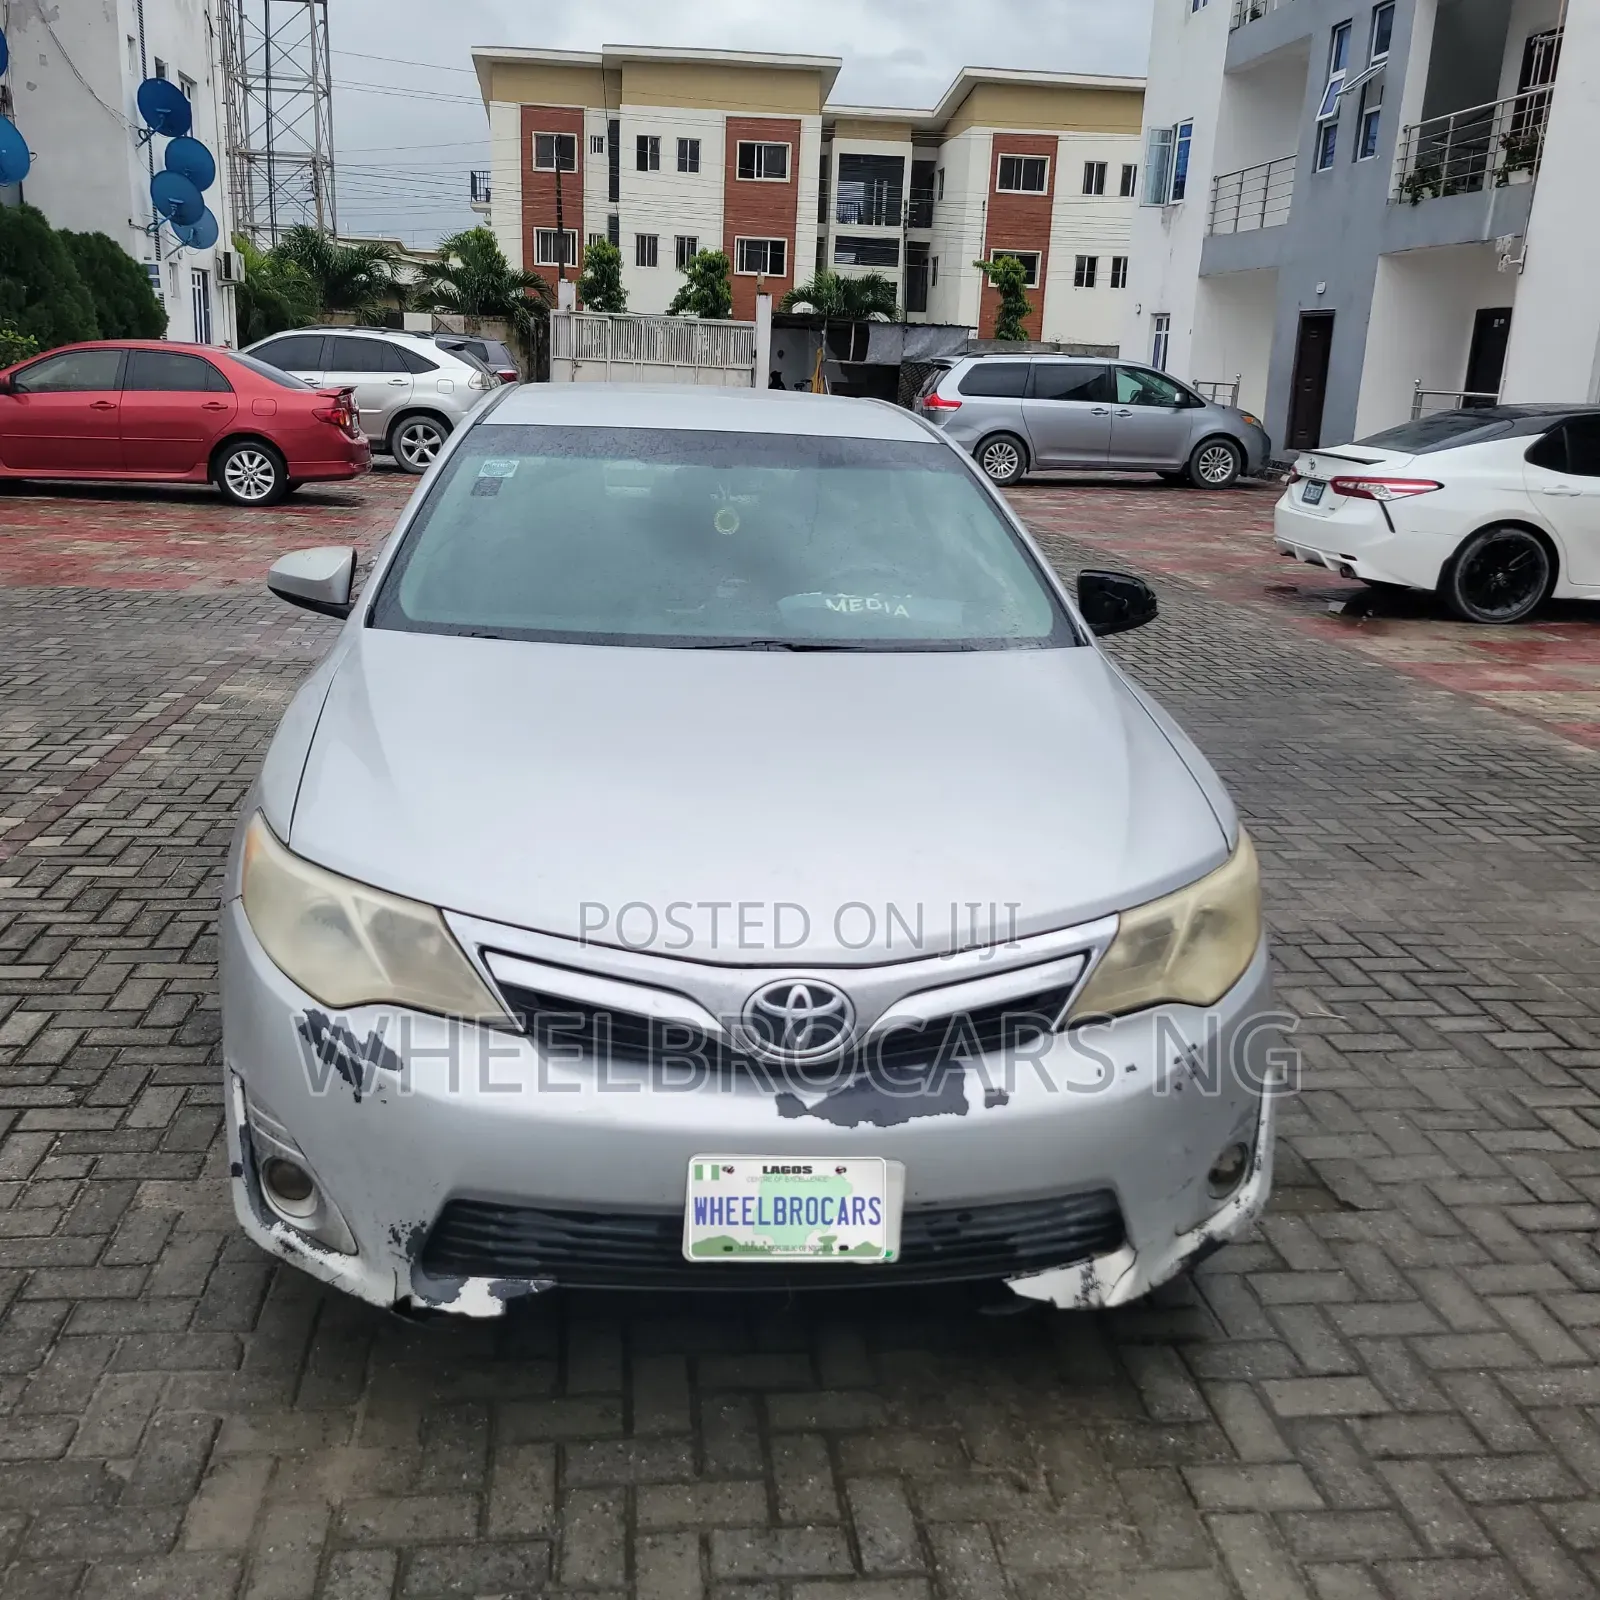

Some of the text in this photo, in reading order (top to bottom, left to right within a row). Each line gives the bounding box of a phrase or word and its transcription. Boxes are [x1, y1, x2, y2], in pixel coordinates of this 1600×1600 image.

[825, 597, 910, 618] MEDIA
[762, 1165, 813, 1175] LAGOS
[694, 1196, 882, 1226] WHEELBROCARS
